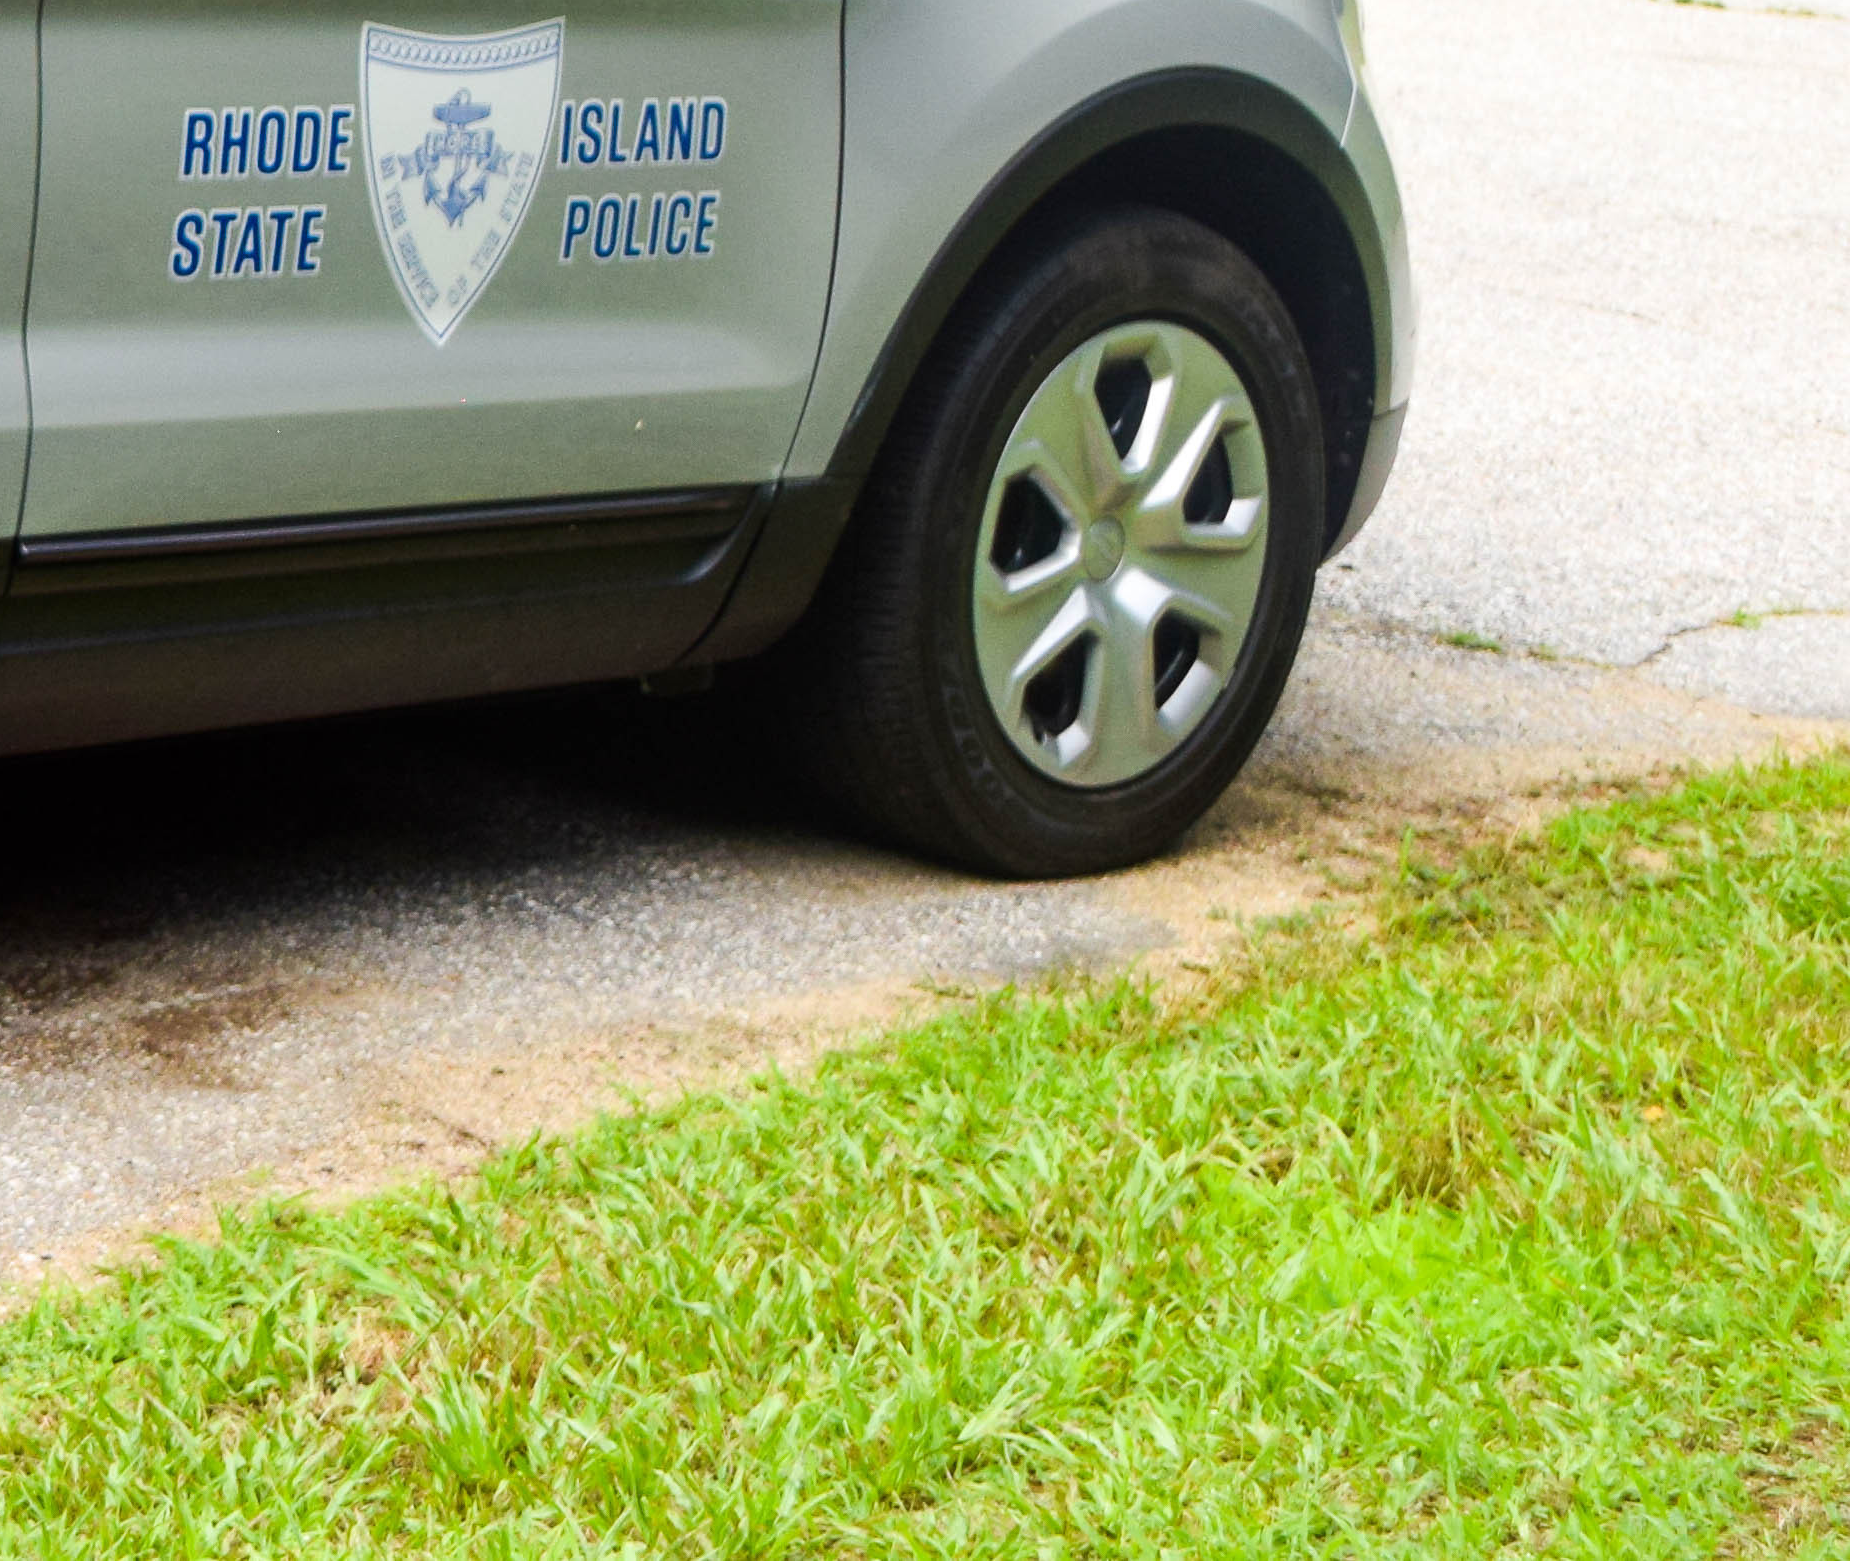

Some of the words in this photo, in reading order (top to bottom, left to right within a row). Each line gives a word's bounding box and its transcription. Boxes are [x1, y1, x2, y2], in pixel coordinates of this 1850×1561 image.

[179, 103, 355, 180] RHODE
[557, 95, 730, 171] ISLAND
[169, 203, 326, 281] STATE
[558, 191, 721, 266] POLICE
